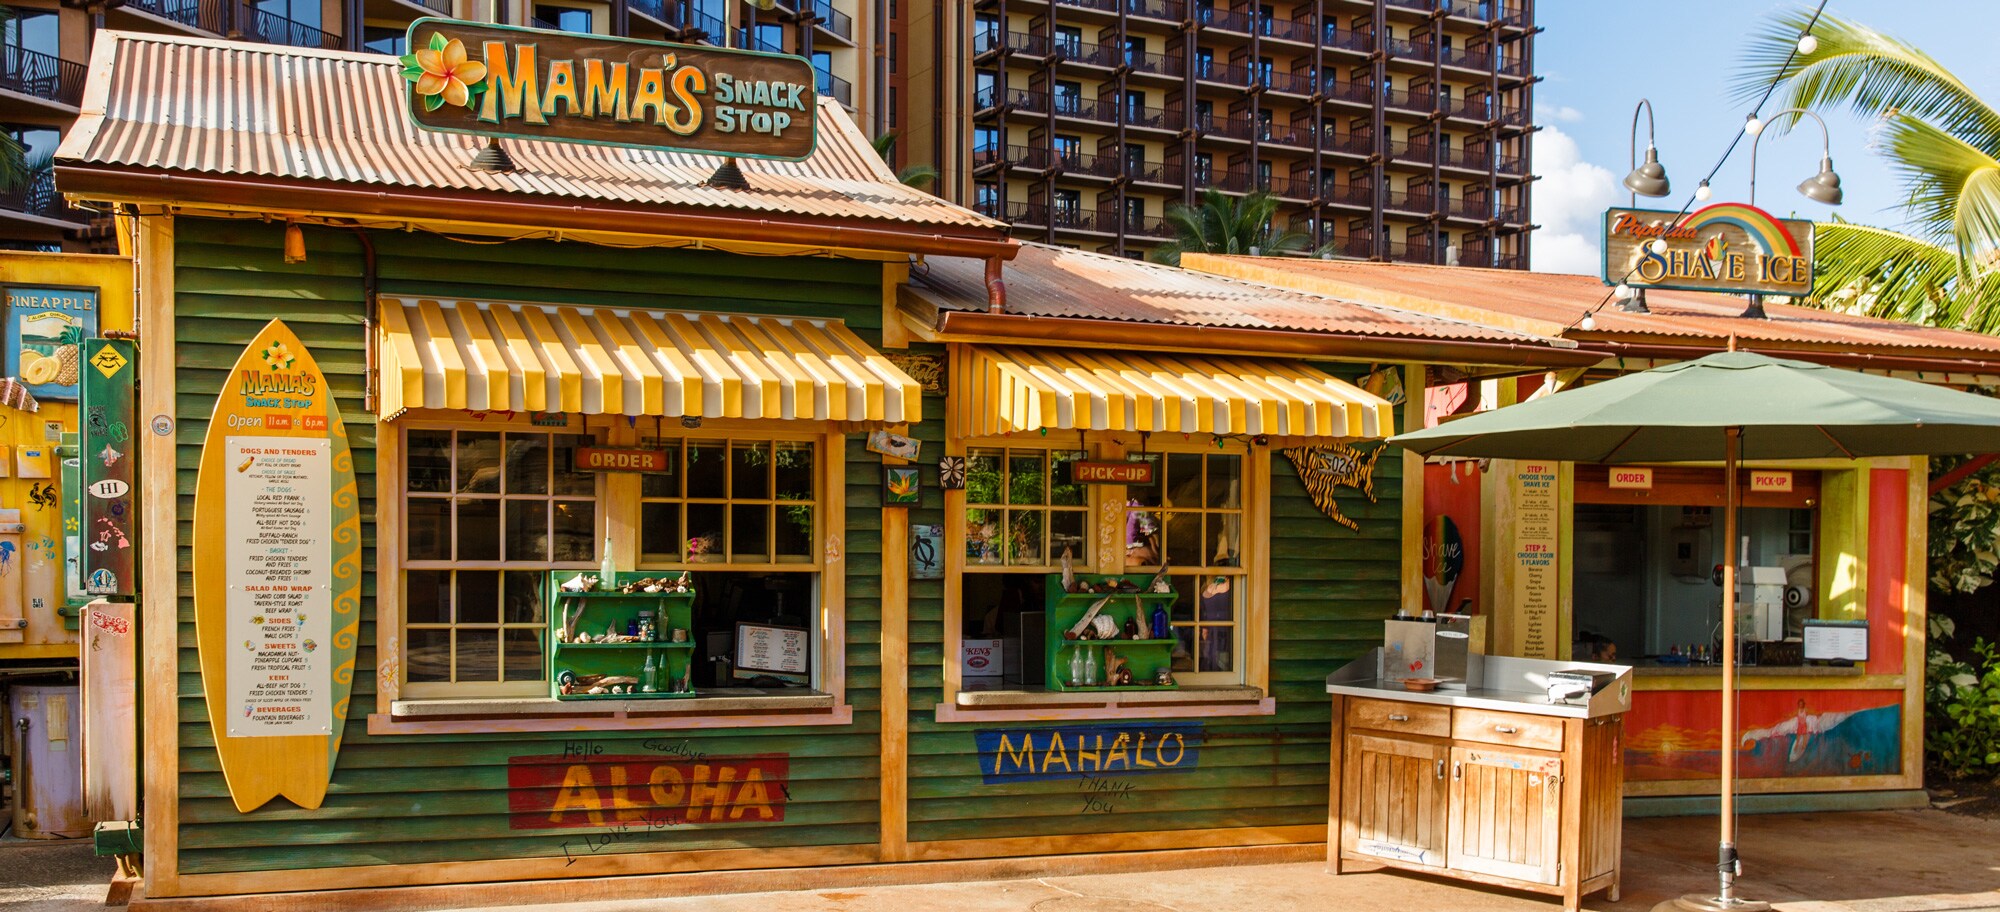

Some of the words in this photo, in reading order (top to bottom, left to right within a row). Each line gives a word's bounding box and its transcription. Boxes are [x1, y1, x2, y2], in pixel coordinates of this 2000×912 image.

[477, 40, 707, 137] MAMA'S
[714, 72, 806, 112] SNACK
[714, 106, 791, 137] STOP
[1758, 255, 1807, 284] ICE
[5, 296, 92, 311] PINEAPPLE
[240, 370, 316, 396] MAMA'S
[246, 396, 281, 408] SNACK
[284, 398, 312, 409] STOP
[227, 414, 262, 430] Open
[590, 453, 653, 468] ORDER
[1080, 467, 1146, 480] PICK-UP
[1616, 473, 1645, 483] ORDER
[1756, 476, 1786, 486] PICK-UP
[100, 482, 118, 494] HI
[563, 740, 603, 759] Hello
[994, 732, 1184, 774] MAHALO
[548, 764, 774, 827] ALOHA
[1078, 773, 1136, 799] THANK
[559, 841, 577, 868] I
[585, 822, 633, 853] LOVE
